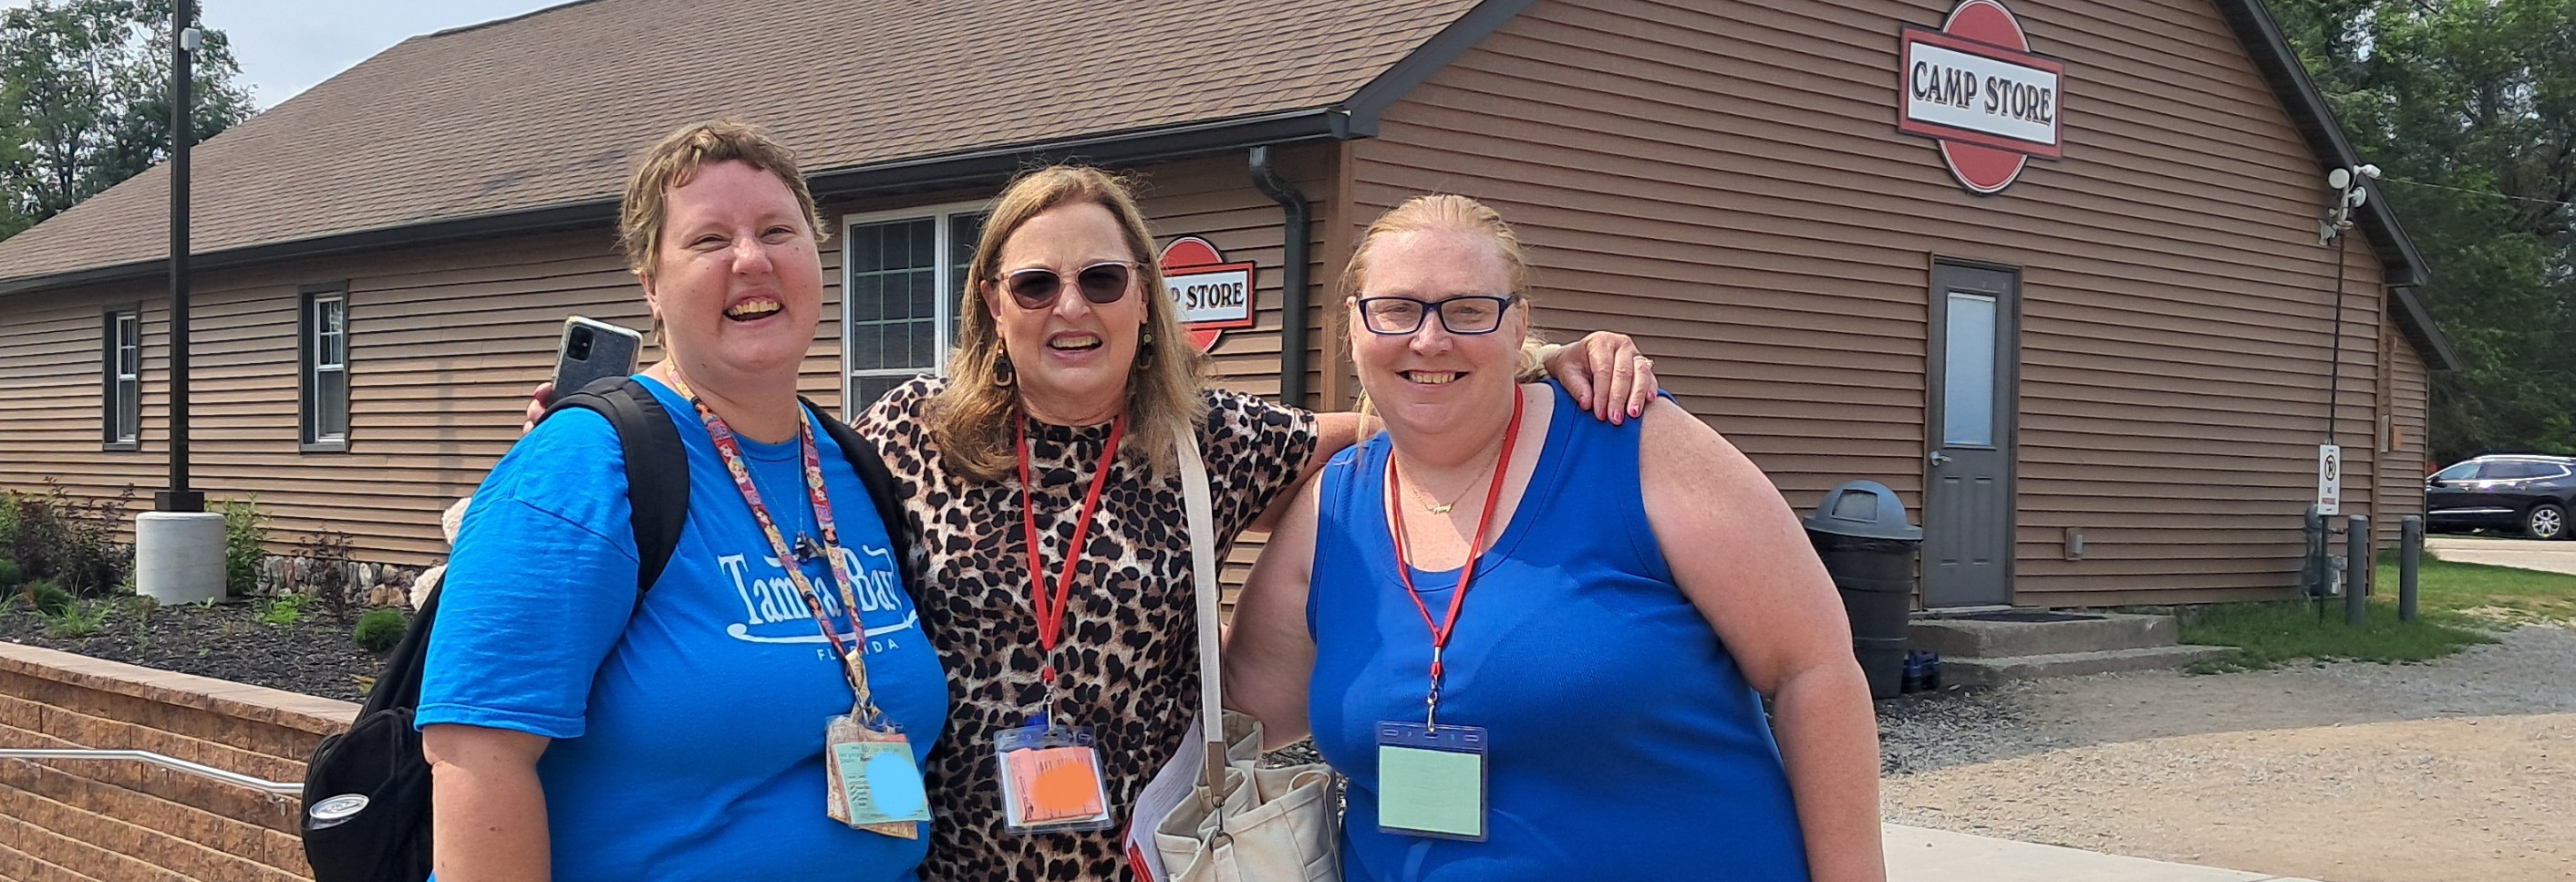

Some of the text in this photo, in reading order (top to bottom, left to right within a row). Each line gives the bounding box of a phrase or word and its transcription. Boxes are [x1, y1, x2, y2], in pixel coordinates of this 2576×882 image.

[1912, 61, 2053, 126] CAMP STORE
[1186, 281, 1244, 310] STORE
[839, 545, 902, 614] Bay
[816, 638, 899, 660] FLIDA
